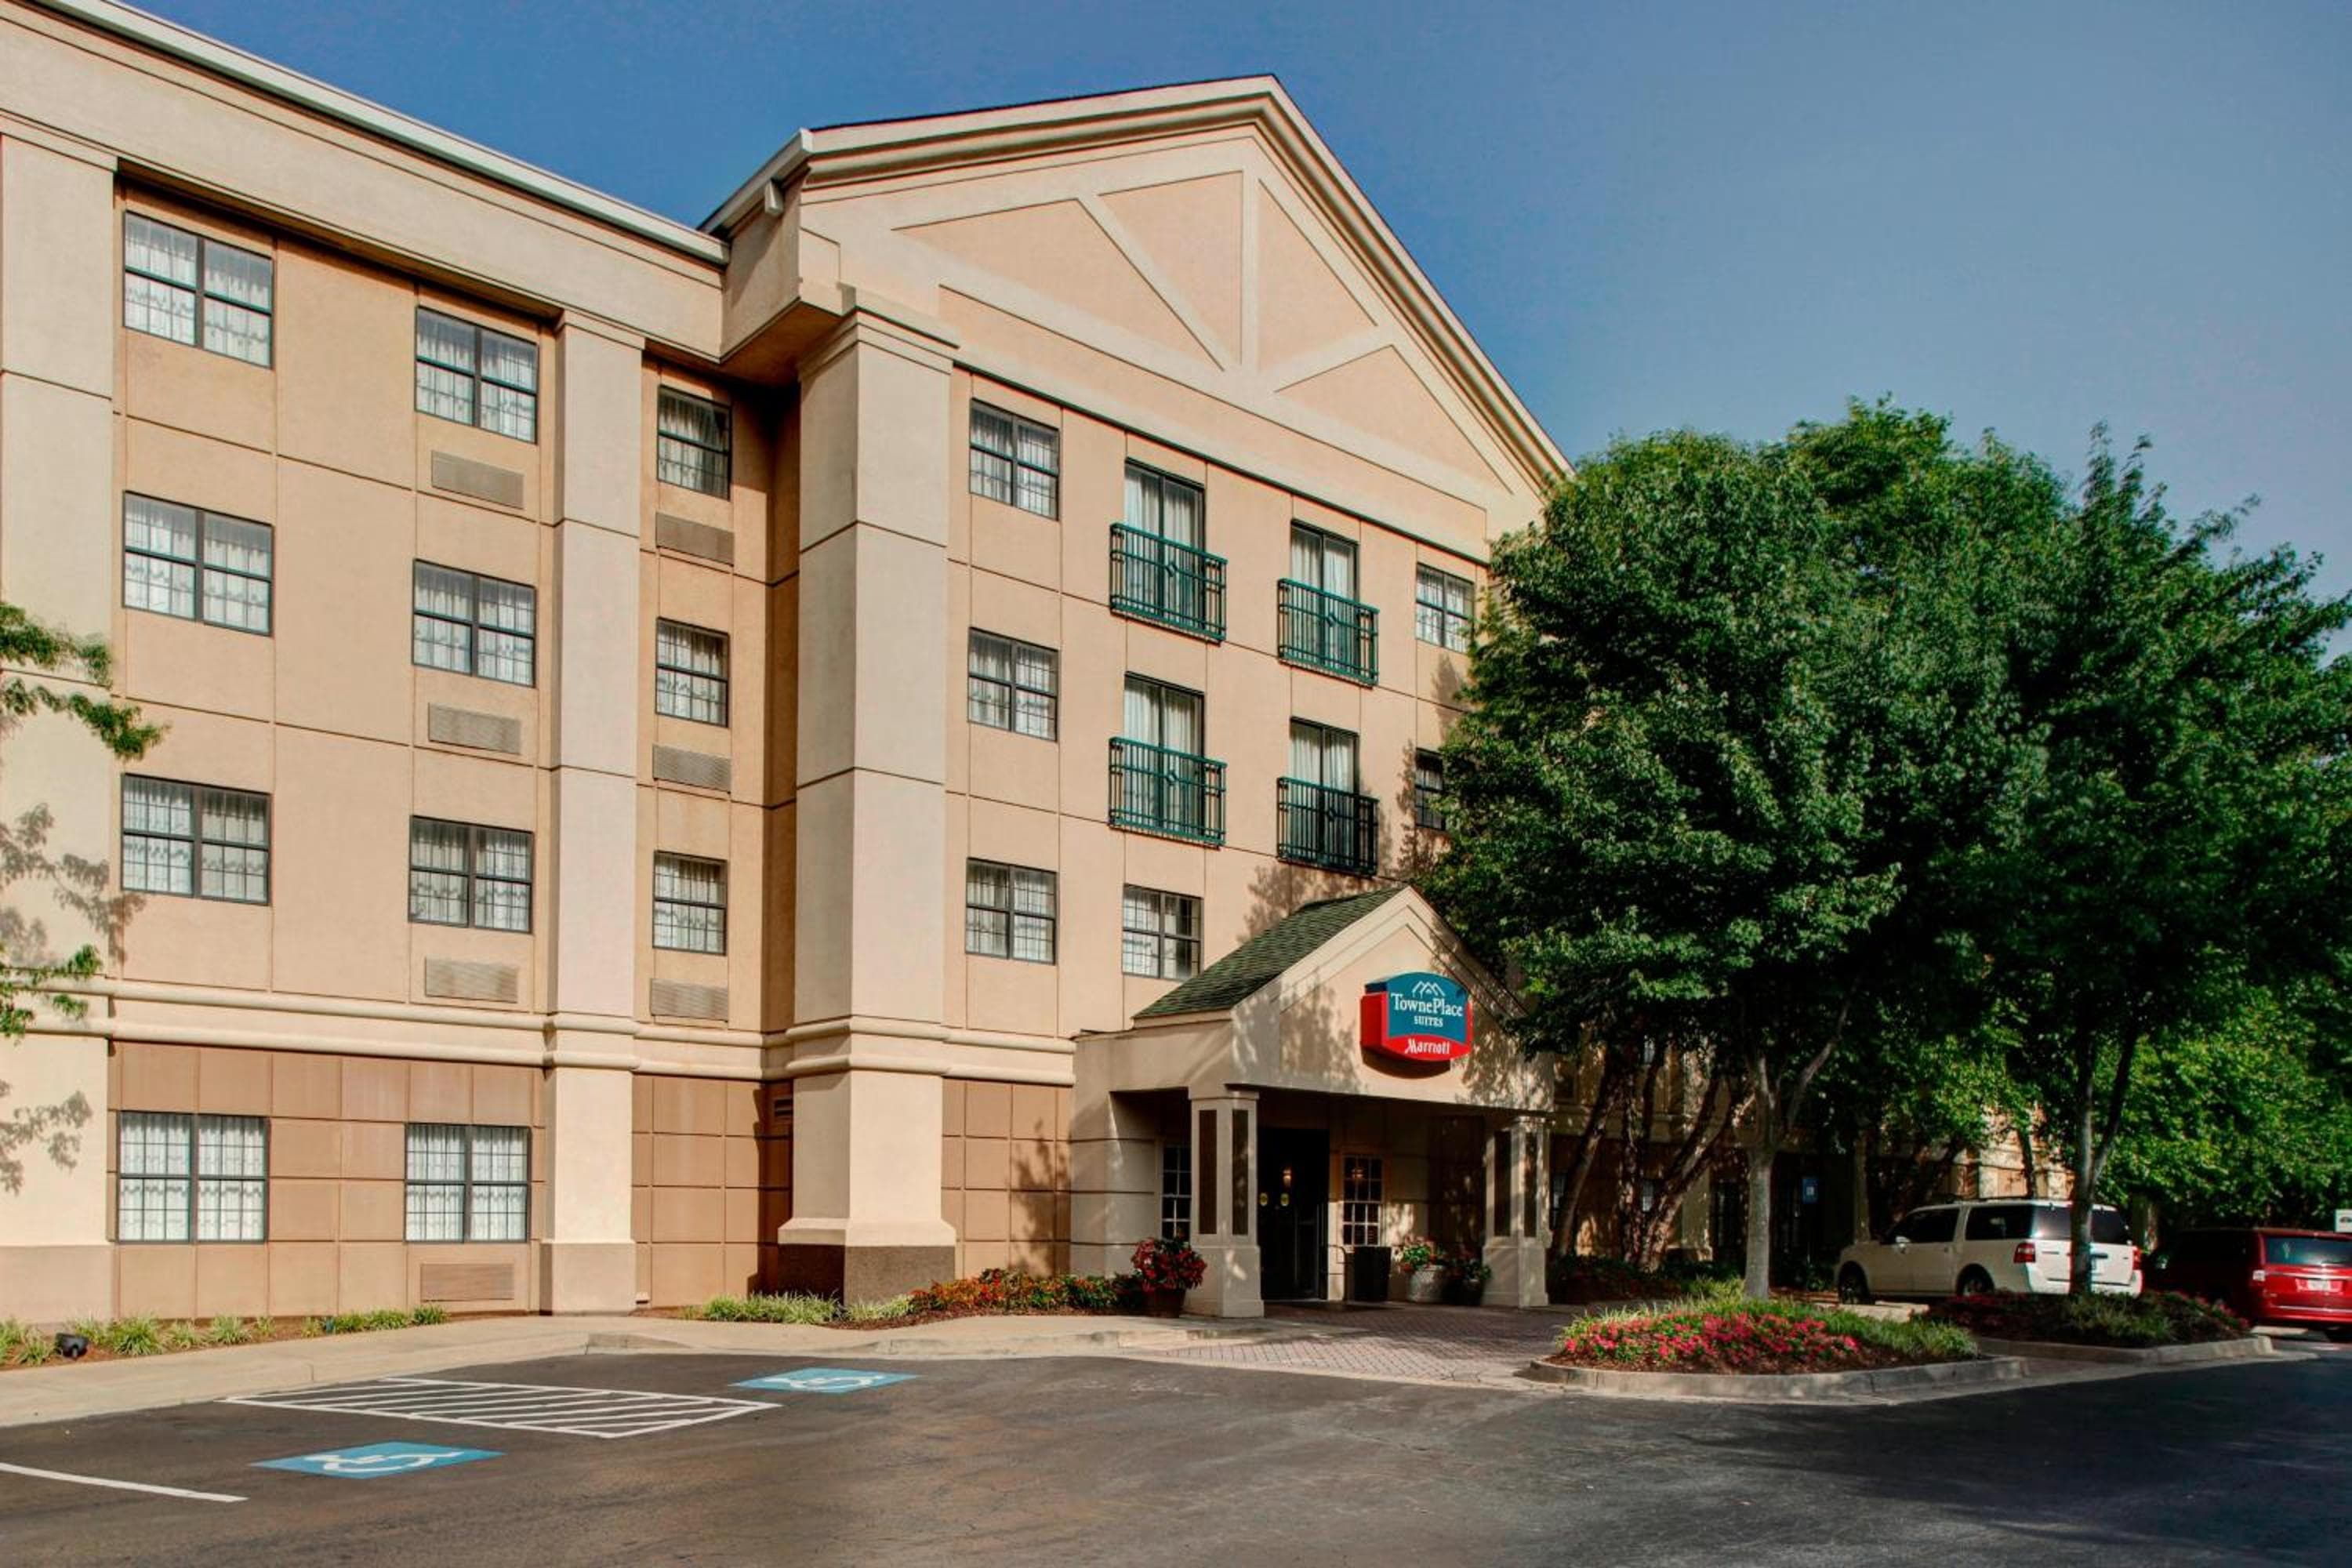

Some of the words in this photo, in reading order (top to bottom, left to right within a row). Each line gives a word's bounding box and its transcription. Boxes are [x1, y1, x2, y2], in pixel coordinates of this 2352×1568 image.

[1391, 993, 1463, 1017] TownePlace
[1414, 1015, 1443, 1027] SUITES
[1405, 1038, 1450, 1054] Marriott
